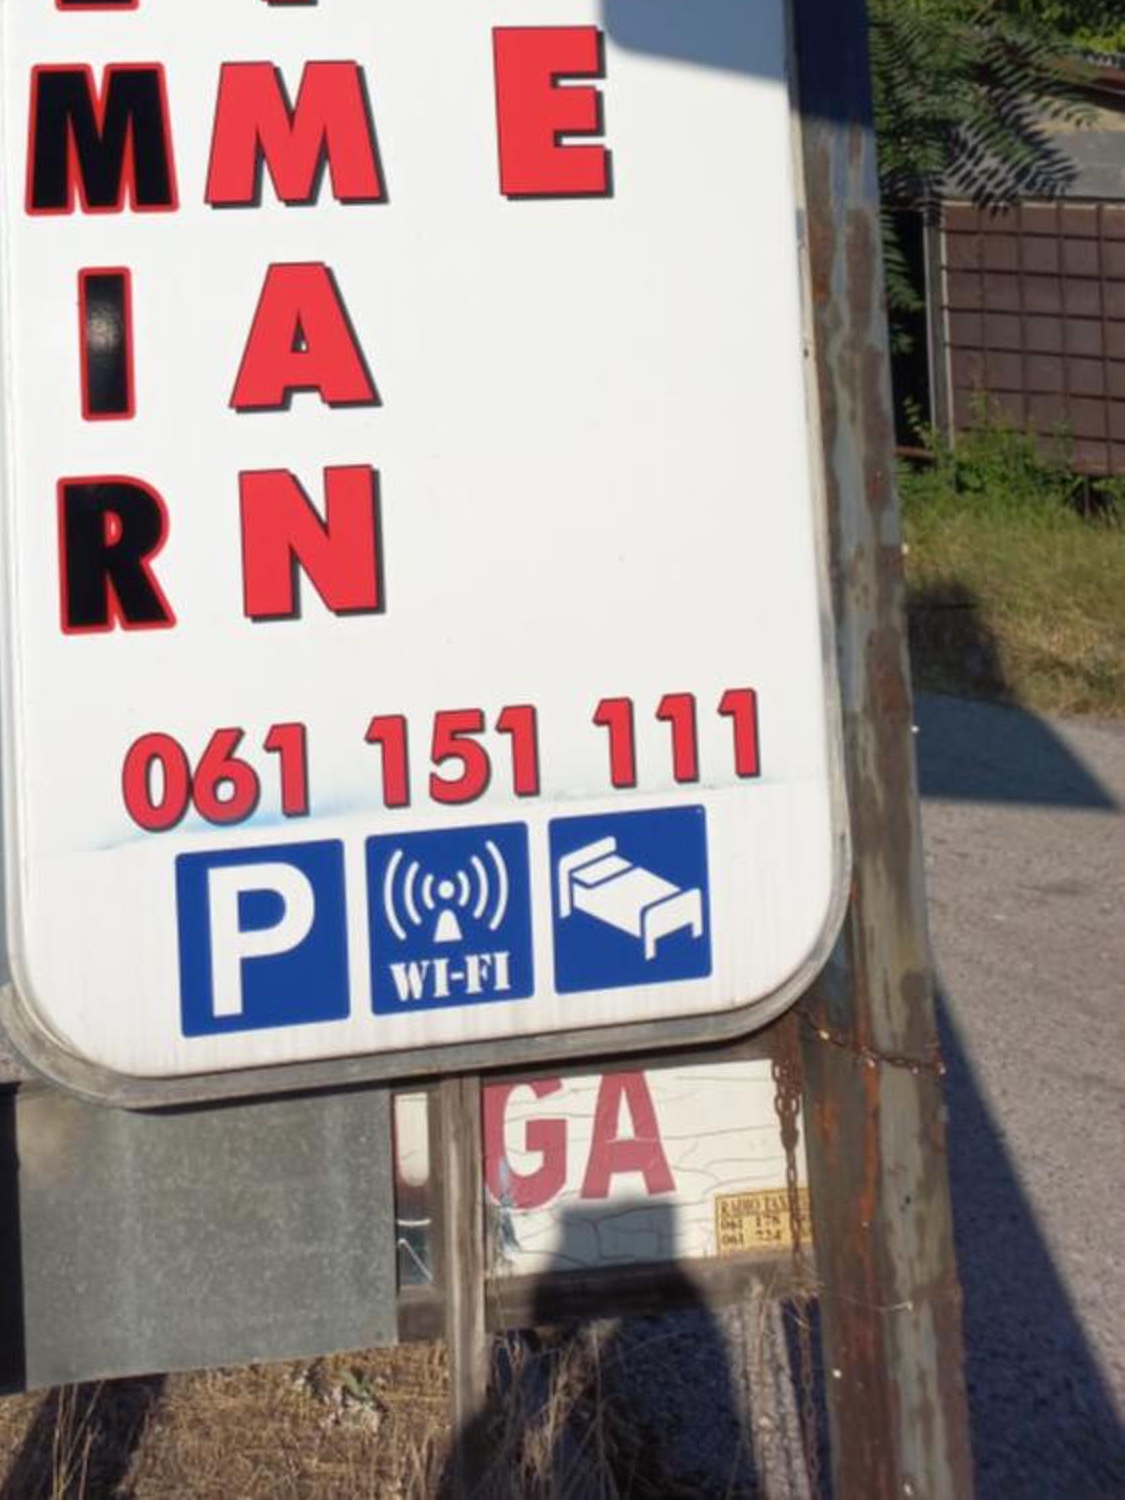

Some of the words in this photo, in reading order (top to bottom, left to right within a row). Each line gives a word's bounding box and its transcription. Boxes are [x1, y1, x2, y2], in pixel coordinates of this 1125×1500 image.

[121, 722, 311, 833] 061
[365, 704, 541, 809] 151
[593, 687, 761, 789] 111
[207, 861, 316, 1019] P
[389, 950, 513, 1003] WI-FI
